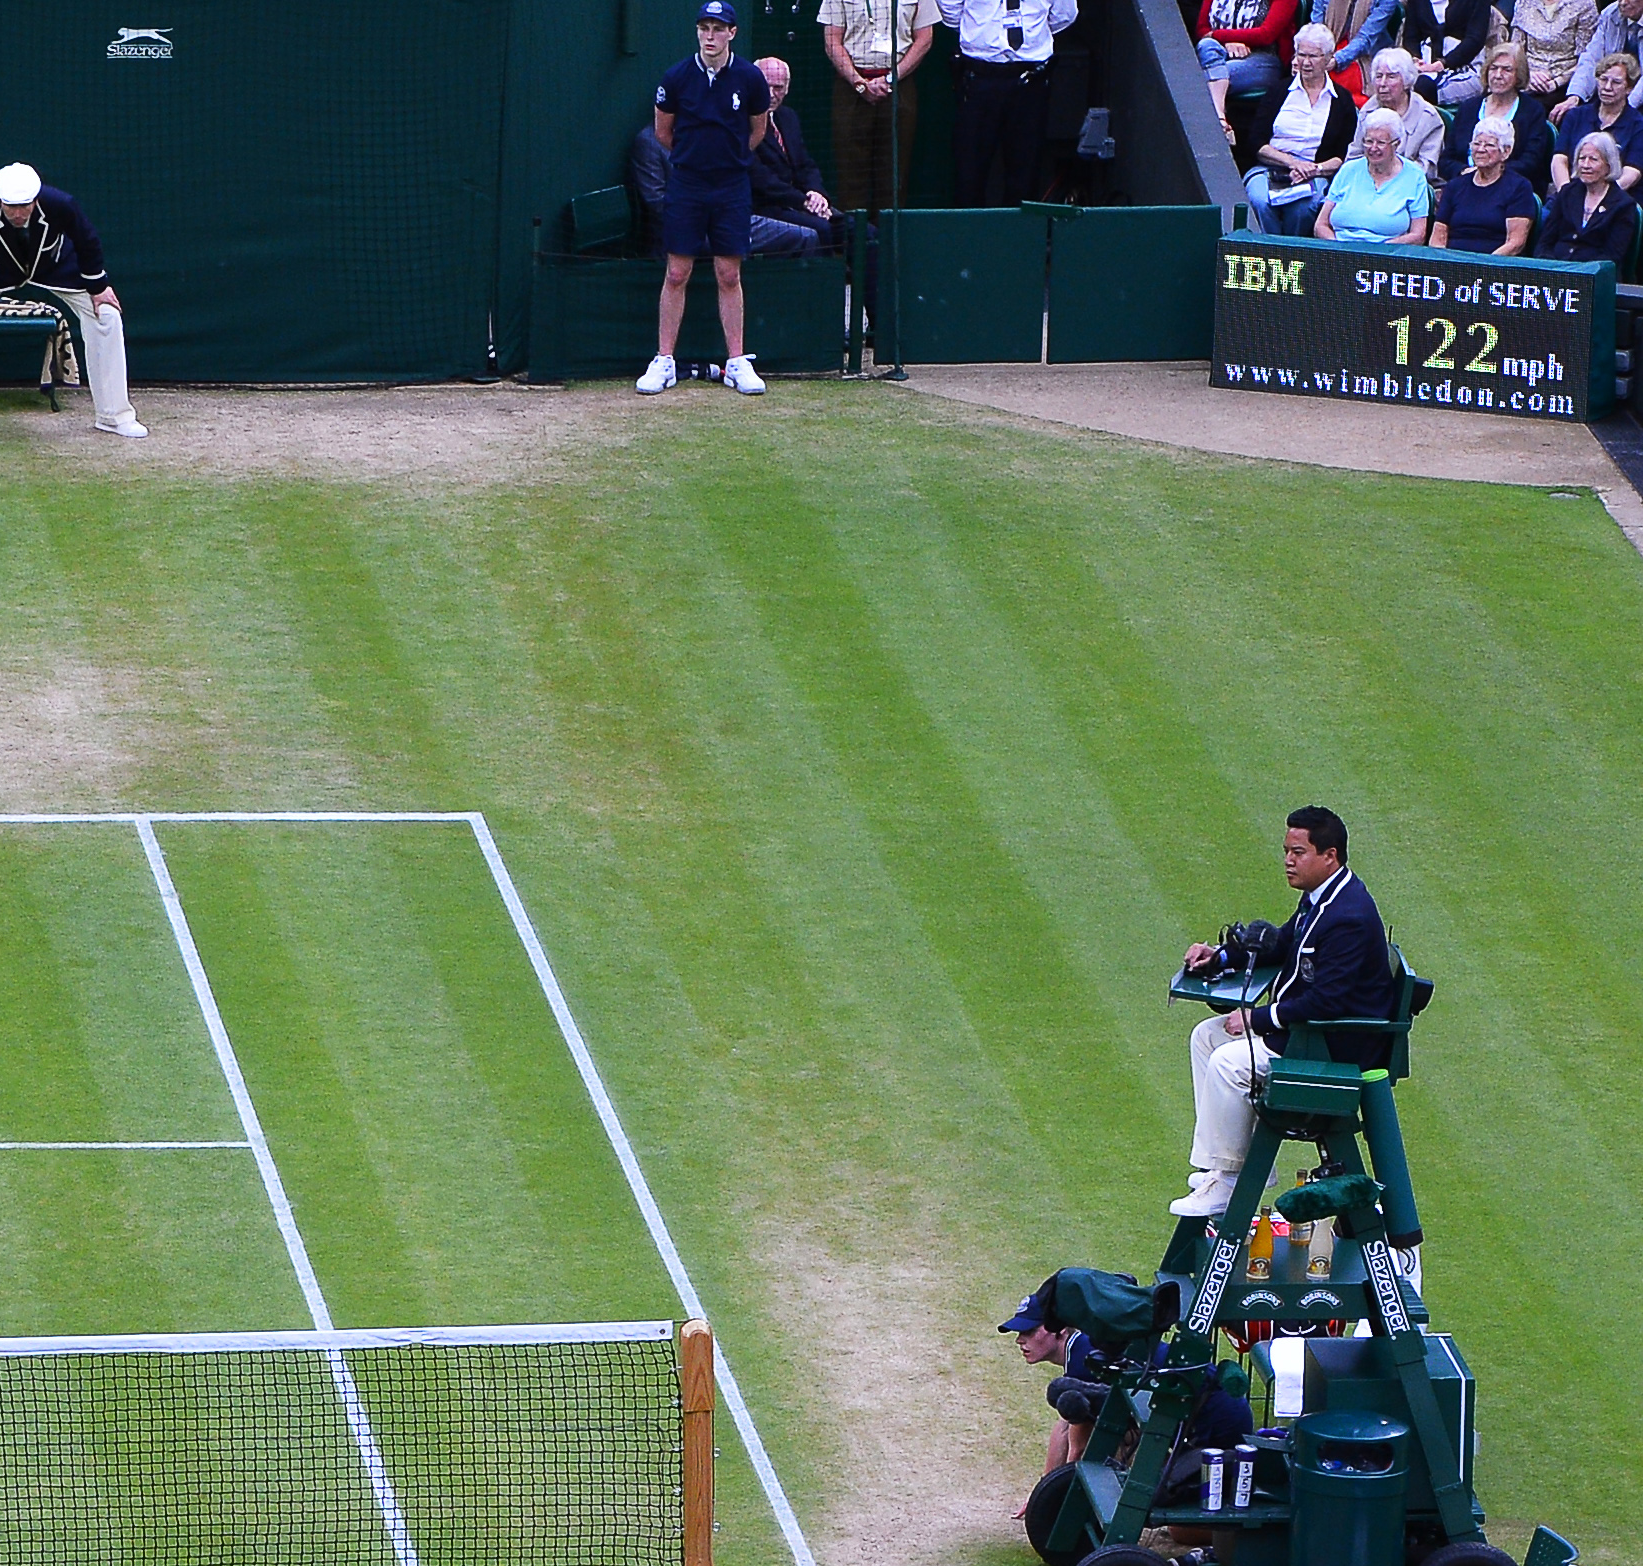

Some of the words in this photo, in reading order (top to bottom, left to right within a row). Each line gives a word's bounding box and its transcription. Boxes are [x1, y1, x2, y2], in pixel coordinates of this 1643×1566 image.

[107, 44, 173, 59] Slazenger
[1223, 254, 1305, 295] IBM
[1355, 270, 1446, 300] SPEED
[1454, 279, 1482, 304] of
[1489, 282, 1580, 313] SERVE
[1387, 315, 1499, 374] 122
[1503, 353, 1563, 387] mph
[1225, 364, 1574, 415] www.wimbledon.com
[1188, 1239, 1237, 1334] Slazenger
[1241, 1292, 1281, 1307] ROBINSONS
[1300, 1292, 1340, 1306] ROBINSONS
[1366, 1240, 1408, 1332] Slazenger
